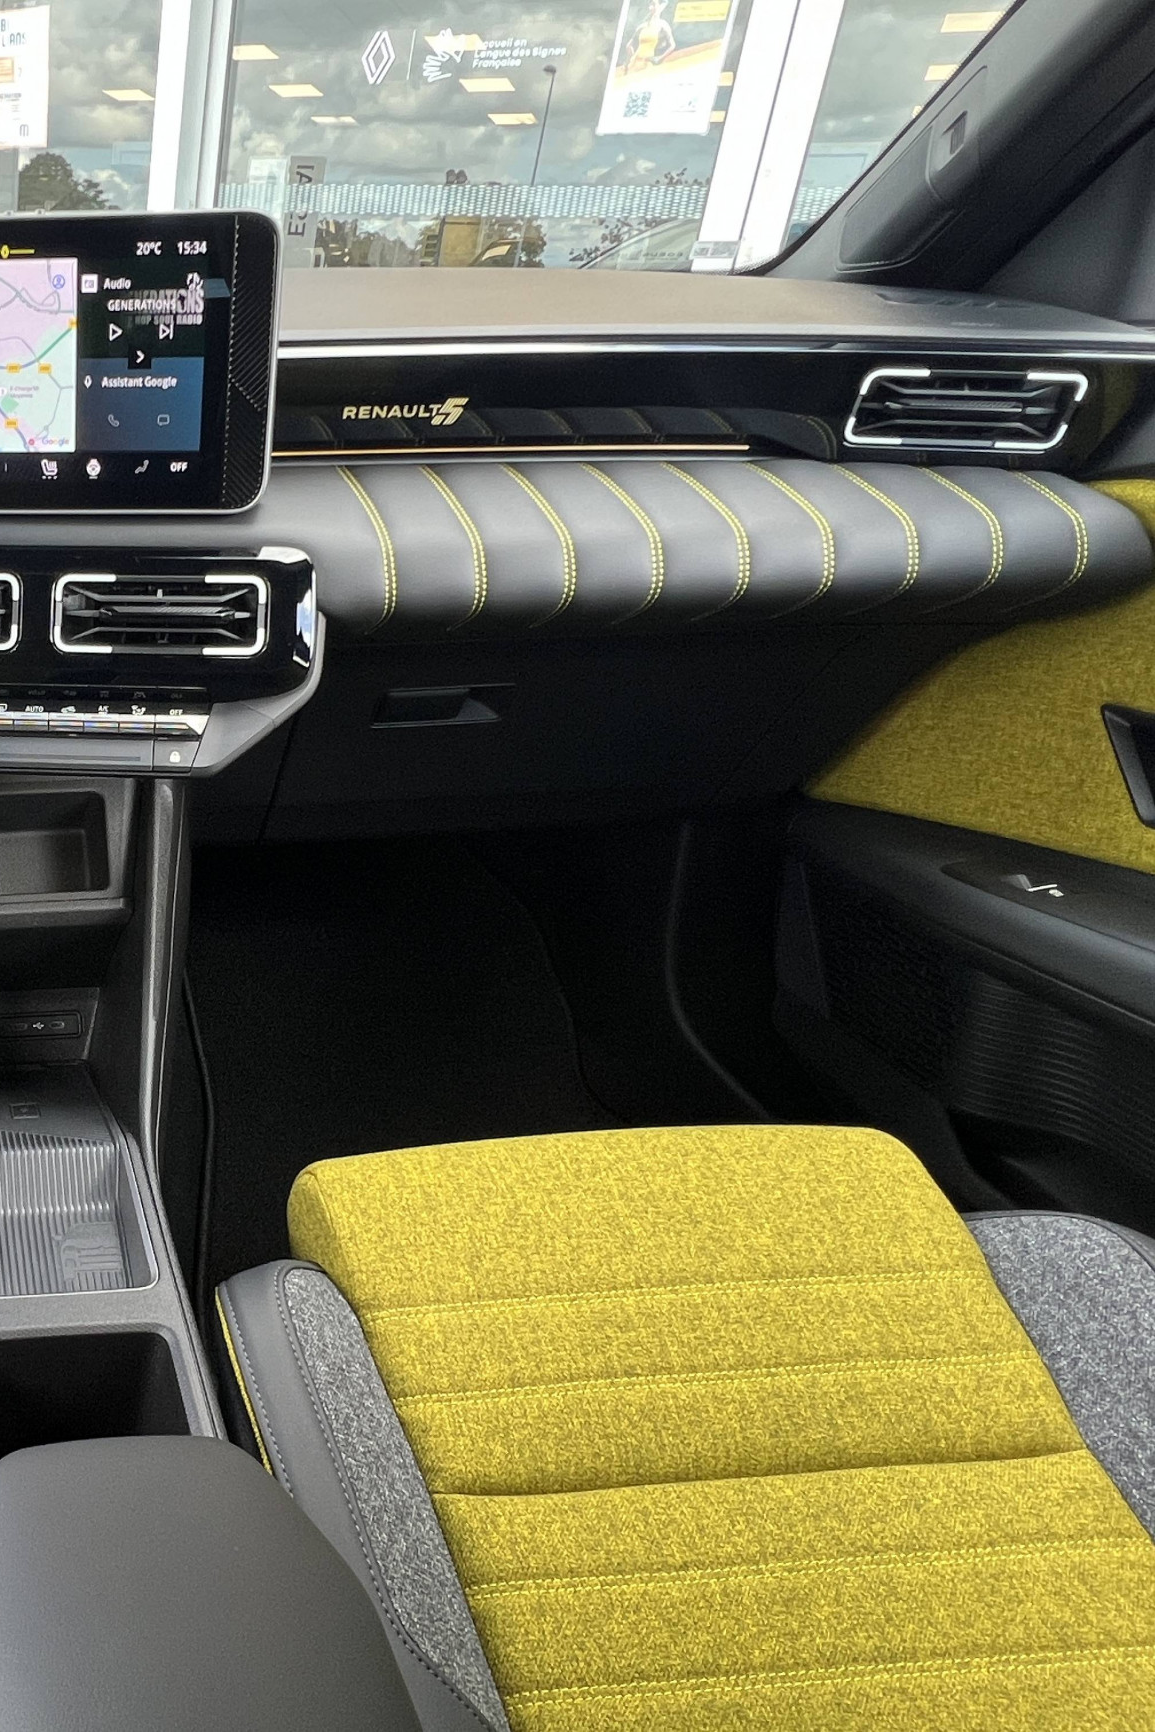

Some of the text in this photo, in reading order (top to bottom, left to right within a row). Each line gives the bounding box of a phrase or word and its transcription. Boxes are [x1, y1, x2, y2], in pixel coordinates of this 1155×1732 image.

[474, 48, 511, 60] Langue
[512, 47, 531, 57] des
[472, 58, 522, 69] Française
[177, 240, 208, 255] 15:34
[103, 277, 132, 290] Audio
[107, 299, 177, 312] GENERATIONS
[101, 376, 178, 390] Assistant Google
[342, 404, 442, 419] RENAULT
[169, 461, 188, 473] OFF
[24, 705, 45, 713] AUTO
[169, 708, 184, 716] OFF
